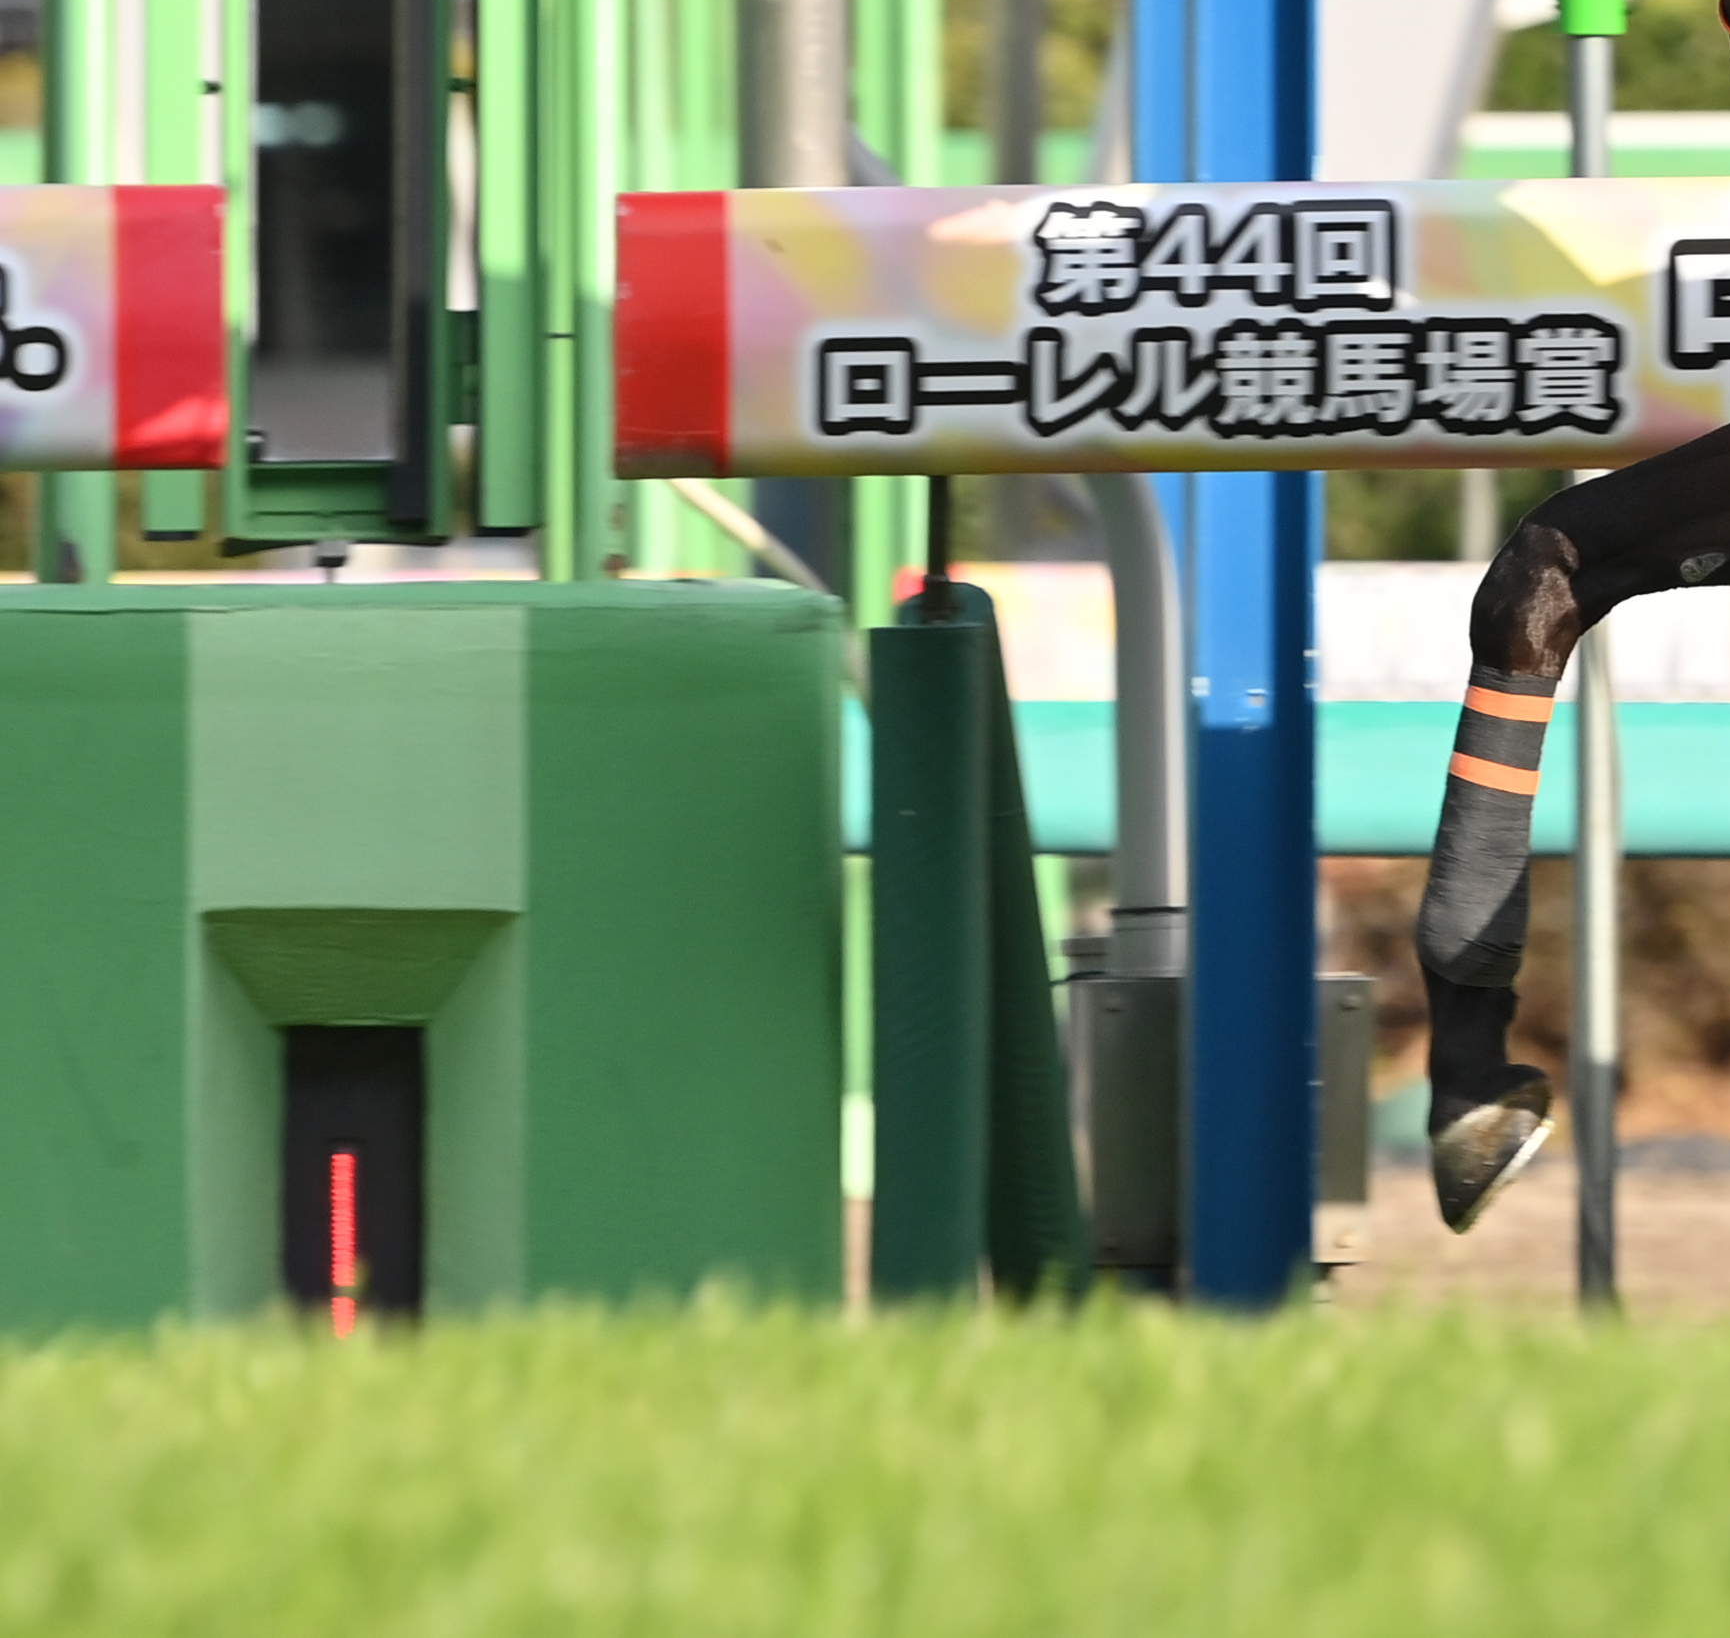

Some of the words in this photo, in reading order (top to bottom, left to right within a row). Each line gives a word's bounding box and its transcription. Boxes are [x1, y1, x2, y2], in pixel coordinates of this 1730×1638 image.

[1035, 200, 1395, 315] 第44回
[819, 314, 1622, 436] ローレル競馬場賞
